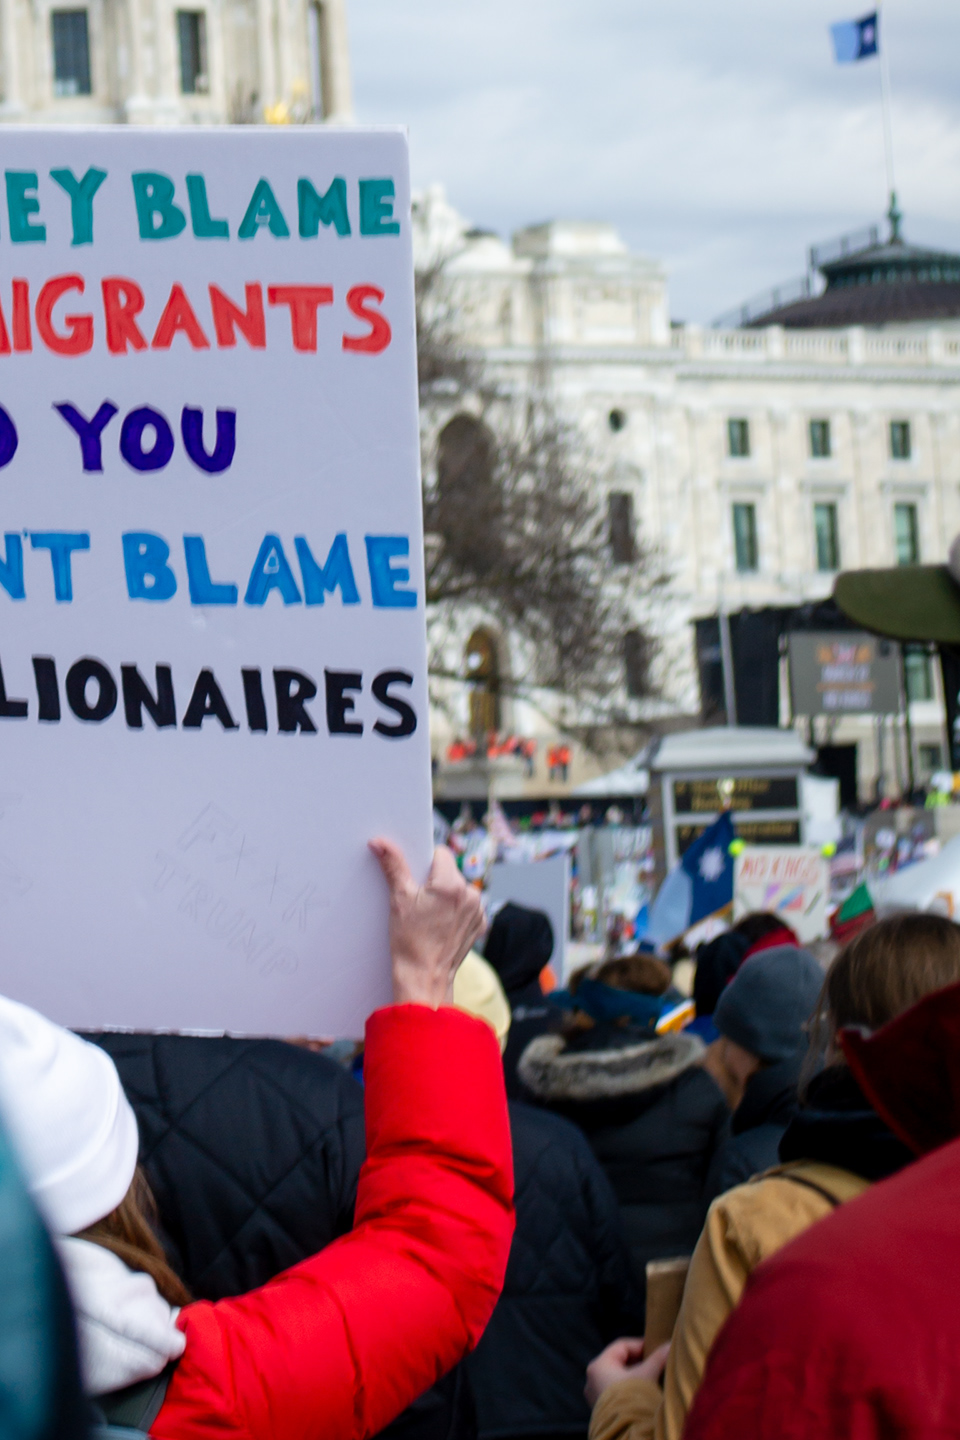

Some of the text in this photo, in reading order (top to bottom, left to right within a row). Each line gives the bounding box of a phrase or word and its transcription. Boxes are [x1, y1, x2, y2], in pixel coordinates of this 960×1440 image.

[131, 171, 401, 241] BLAME
[51, 398, 237, 476] YOU
[121, 531, 418, 609] BLAME
